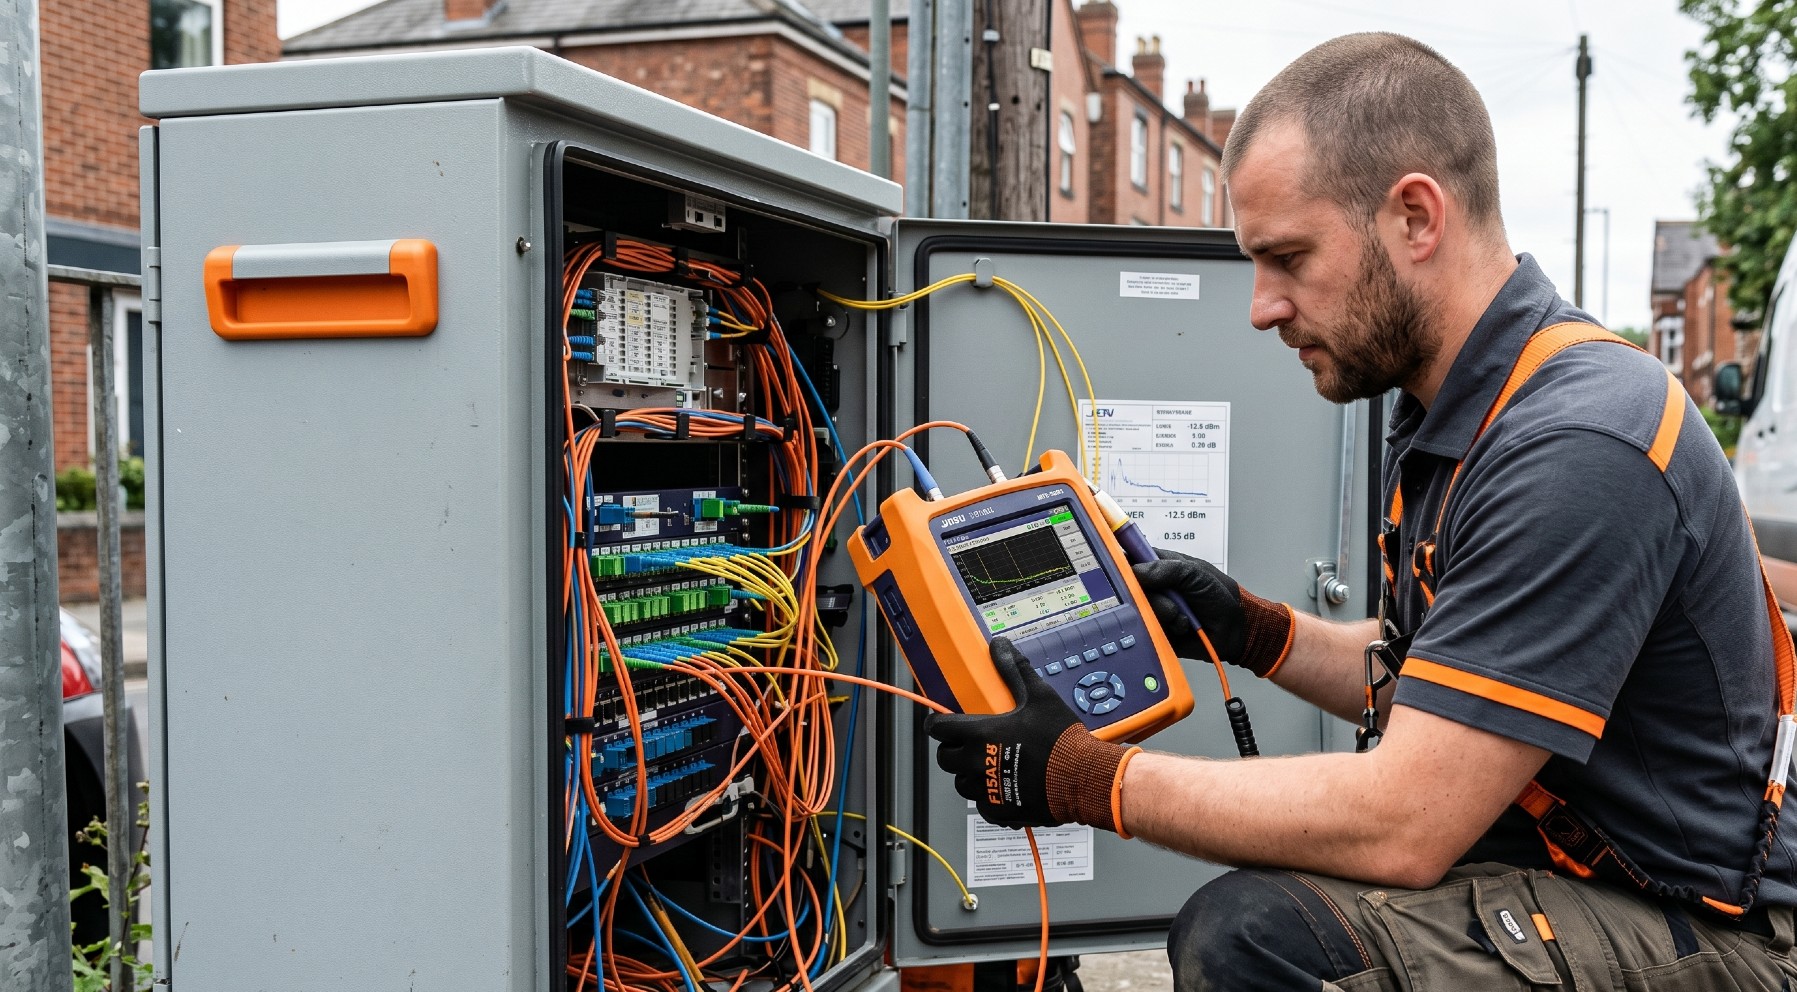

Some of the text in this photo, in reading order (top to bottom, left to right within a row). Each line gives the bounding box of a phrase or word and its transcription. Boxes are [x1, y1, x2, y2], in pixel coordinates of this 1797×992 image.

[1165, 511, 1206, 519] -12.5 dBm
[1164, 532, 1196, 540] 0.35 dB
